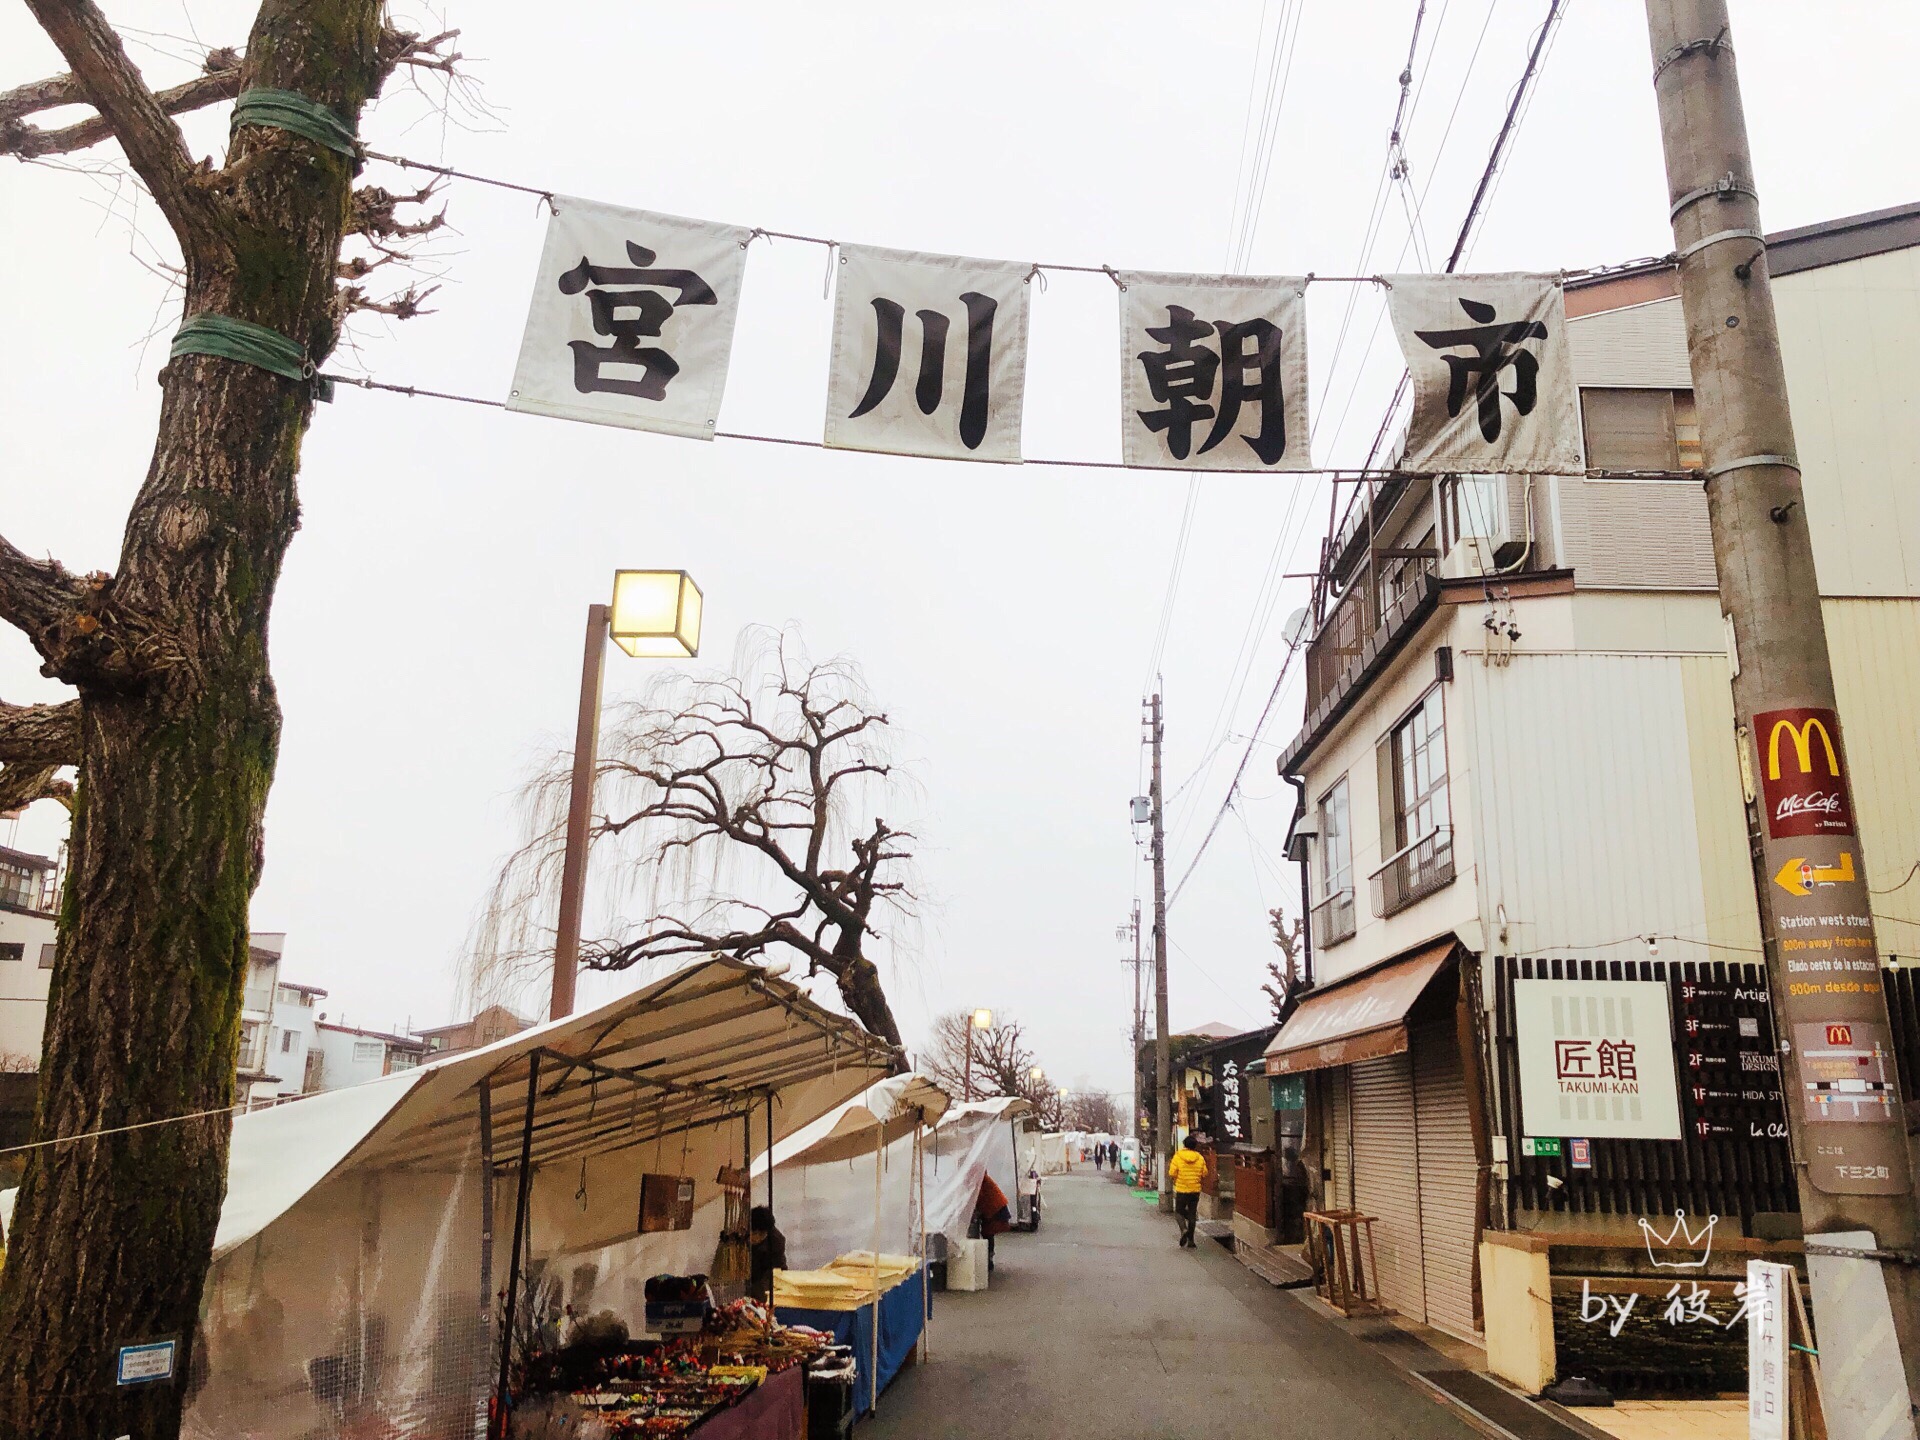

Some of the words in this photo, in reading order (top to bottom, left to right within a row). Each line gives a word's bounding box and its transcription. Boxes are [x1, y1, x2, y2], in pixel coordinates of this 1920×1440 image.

[1780, 915, 1816, 929] Station
[1819, 914, 1845, 926] west
[1846, 914, 1871, 928] street
[1808, 939, 1833, 950] away
[1833, 957, 1843, 970] de
[1844, 958, 1851, 971] la
[1682, 986, 1696, 998] 3F
[1789, 982, 1821, 996] 900m
[1685, 1020, 1700, 1032] 3F
[1555, 1039, 1638, 1081] 匠館
[1689, 1053, 1703, 1066] 2F
[1740, 1055, 1778, 1064] TAKUMI
[1741, 1063, 1778, 1071] DESIGN
[1558, 1081, 1639, 1094] TAKUMI-KAN
[1692, 1088, 1706, 1100] 1F
[1742, 1091, 1766, 1100] HIDA
[1696, 1122, 1710, 1135] 1F
[1750, 1122, 1764, 1136] La
[1817, 1145, 1844, 1155] ここは
[1835, 1165, 1889, 1180] 下三之町
